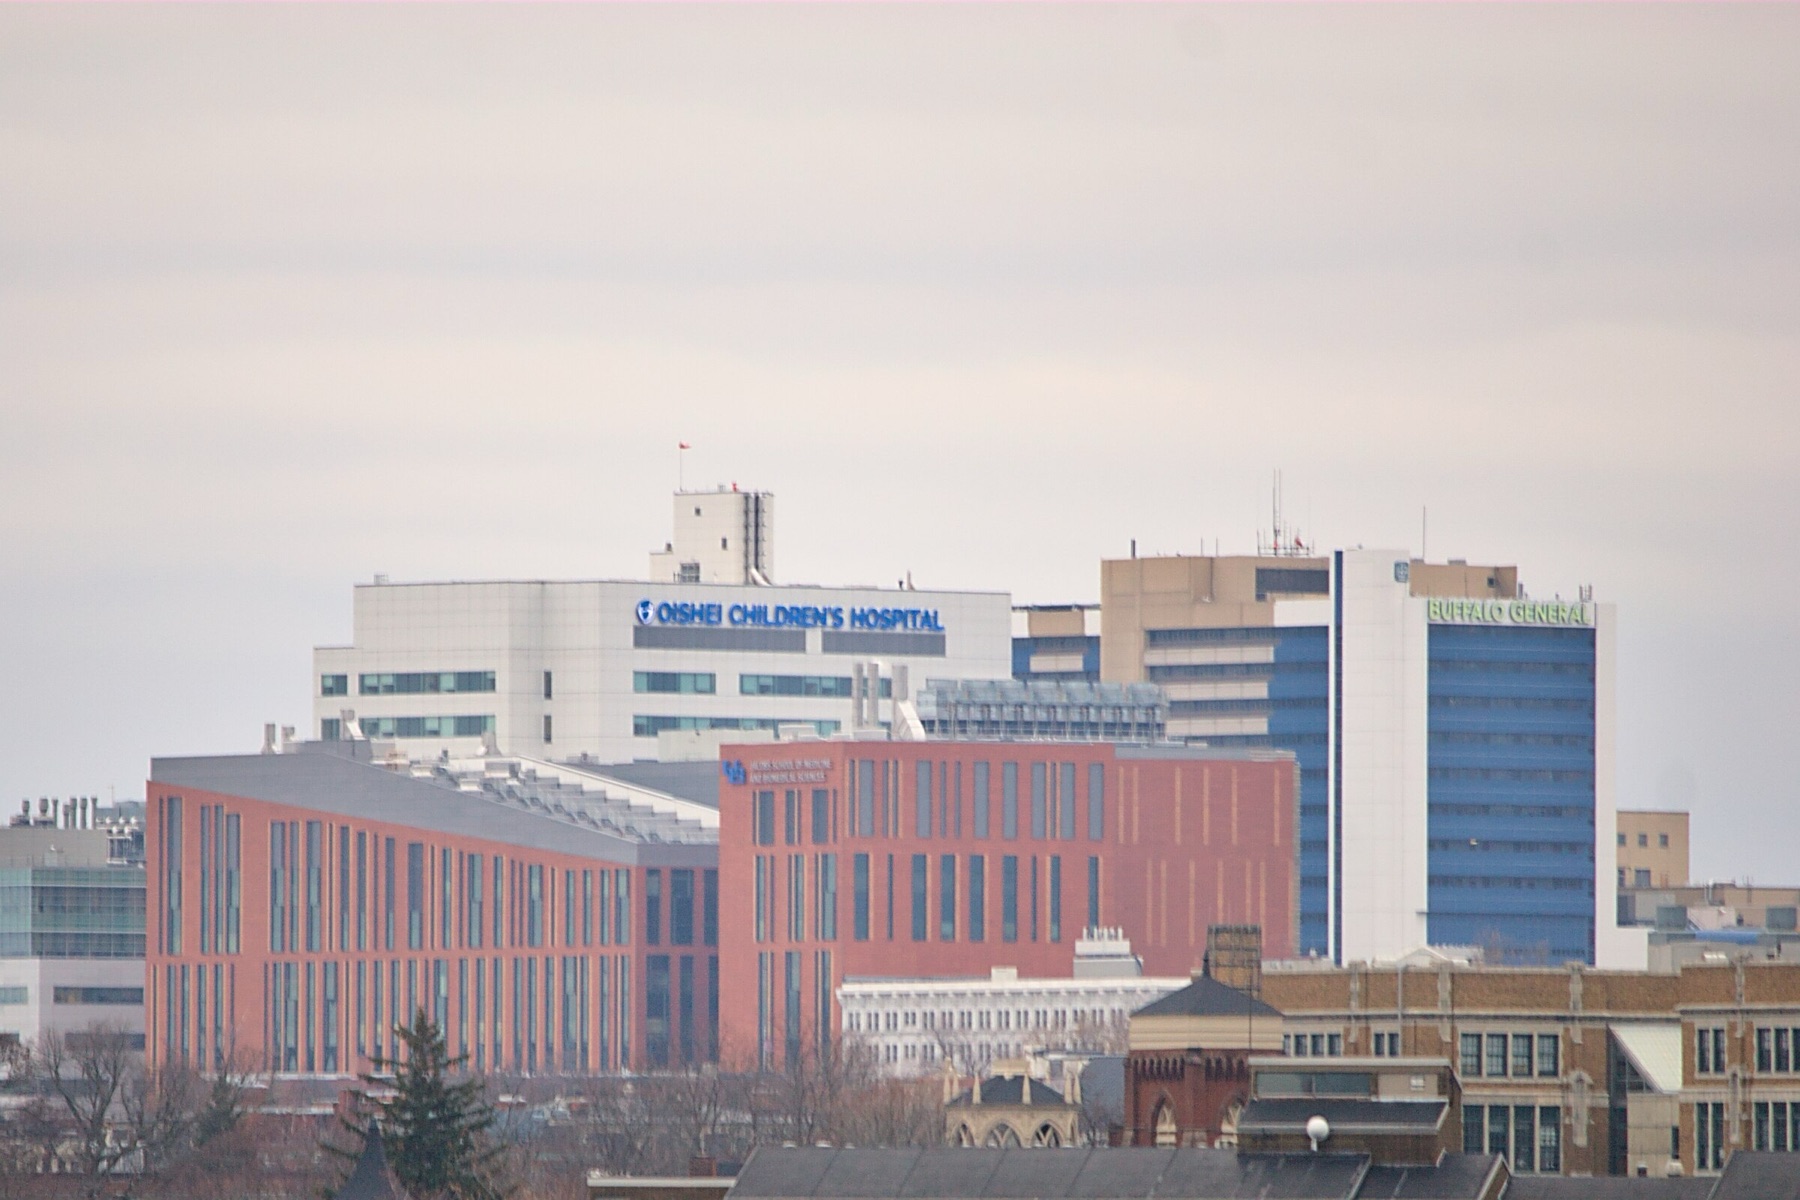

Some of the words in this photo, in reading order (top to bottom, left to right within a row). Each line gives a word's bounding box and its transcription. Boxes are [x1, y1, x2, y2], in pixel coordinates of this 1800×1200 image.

[657, 603, 722, 624] OISHEI
[729, 605, 844, 627] CHILDREN'S
[851, 607, 945, 630] HOSPITAL
[1428, 601, 1506, 622] BUFFALO
[1510, 602, 1591, 624] GENERAL
